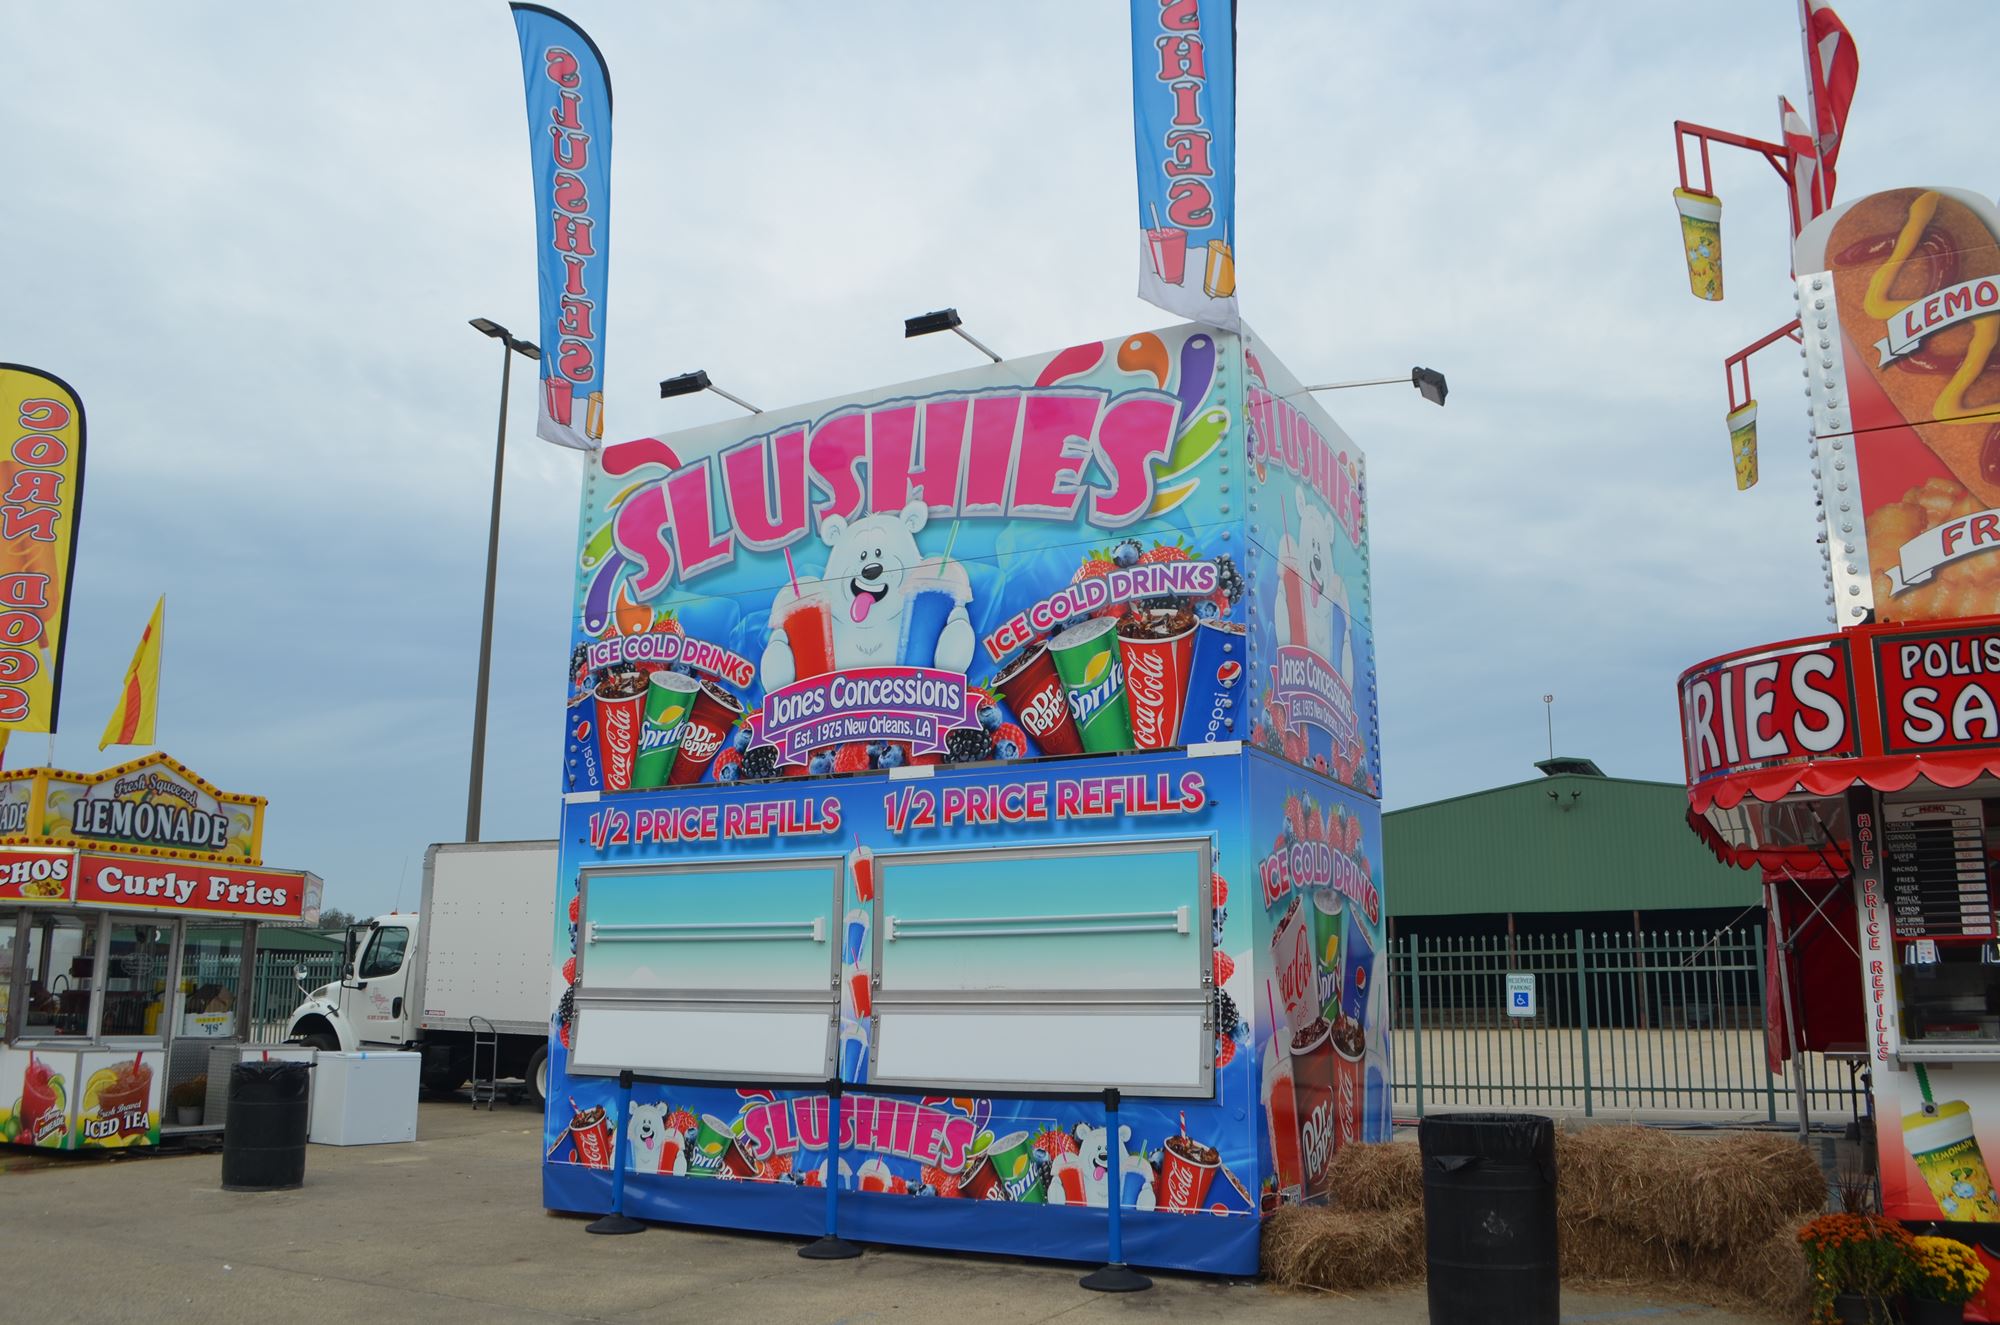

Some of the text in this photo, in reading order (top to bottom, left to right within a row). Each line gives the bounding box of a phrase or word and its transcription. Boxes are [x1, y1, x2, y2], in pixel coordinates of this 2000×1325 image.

[1905, 280, 1999, 338] LEMO
[612, 385, 1183, 603] SLUSHIES
[1248, 386, 1361, 549] SLUSHIES
[1941, 513, 2000, 557] FR
[984, 561, 1217, 662] ICE COLD DRINKS
[588, 634, 755, 688] ICE COLD DRINKS
[1281, 653, 1352, 723] Jones Concessions
[769, 673, 960, 728] Jones Concessions
[1902, 683, 1999, 744] SA
[638, 717, 686, 751] Sprite
[680, 723, 722, 757] Pepper
[794, 717, 931, 749] Est. 1975 New Orleans, LA
[114, 773, 198, 808] Fresh Squeezed
[584, 742, 599, 786] pepsi
[73, 799, 228, 849] LEMONADE
[589, 796, 841, 850] 1/2 PRICE REFILLS
[884, 771, 1206, 834] 1/2 PRICE REFILLS
[96, 866, 287, 907] Curly Fries
[1259, 842, 1379, 926] ICE COLD DRINKS
[1857, 813, 1889, 1062] HALF PRICE REFILLS
[84, 1111, 150, 1138] ICED TEA
[743, 1094, 978, 1175] SLUSHIES
